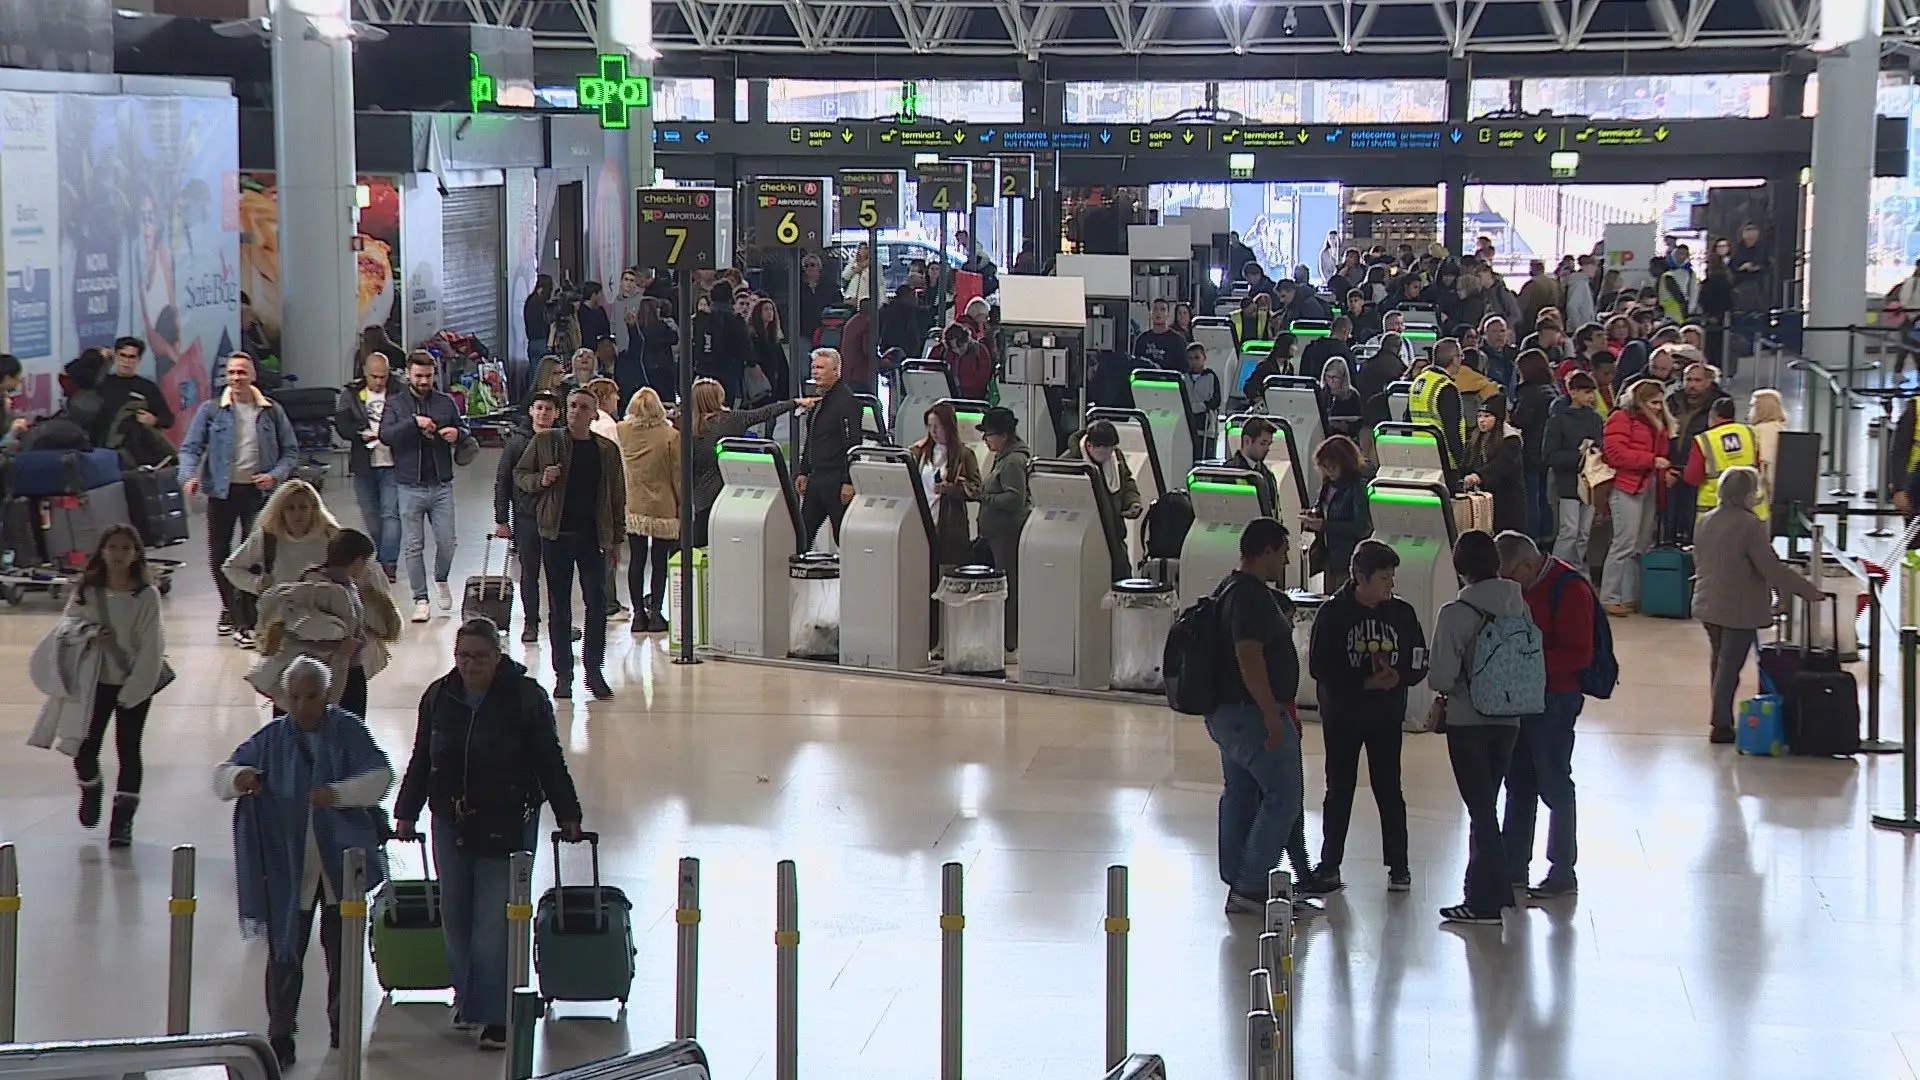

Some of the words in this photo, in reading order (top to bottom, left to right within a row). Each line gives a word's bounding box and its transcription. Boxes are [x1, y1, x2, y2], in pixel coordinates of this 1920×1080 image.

[902, 130, 934, 139] terminal
[935, 131, 941, 139] 2
[1004, 131, 1047, 140] autocarros
[1244, 130, 1277, 139] terminal
[1279, 131, 1284, 139] 2
[1351, 131, 1396, 139] autocarros
[1598, 129, 1634, 138] terminal
[843, 174, 875, 182] check-in
[760, 182, 796, 192] check-in
[1002, 175, 1016, 195] 2
[842, 186, 858, 196] TAP
[644, 193, 685, 204] check-in
[758, 195, 777, 208] TAP
[932, 187, 950, 210] 4
[642, 208, 664, 222] TAP
[858, 200, 878, 227] 5
[776, 211, 800, 245] 6
[665, 227, 688, 265] 7
[1723, 434, 1740, 451] M
